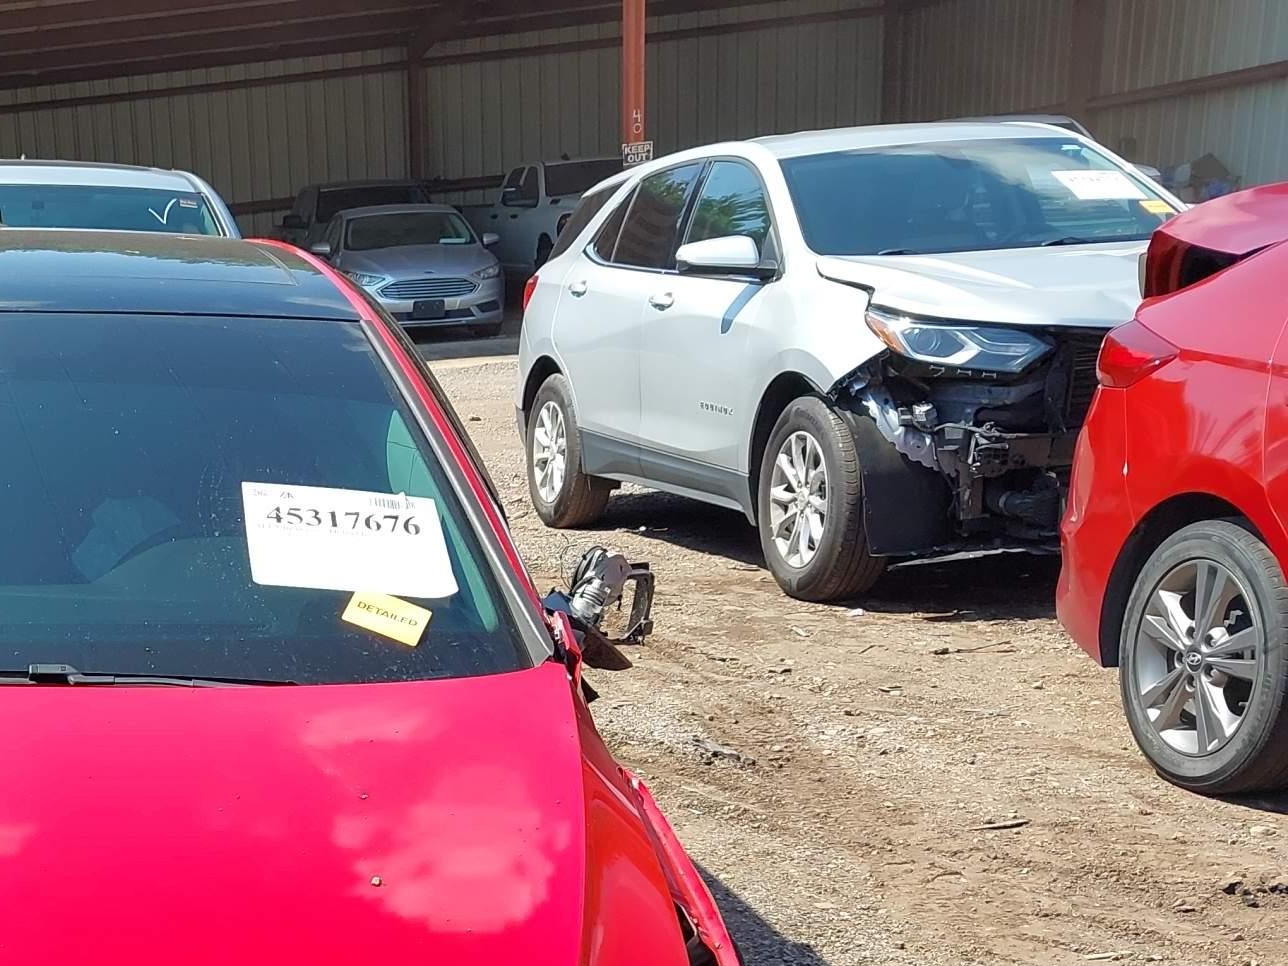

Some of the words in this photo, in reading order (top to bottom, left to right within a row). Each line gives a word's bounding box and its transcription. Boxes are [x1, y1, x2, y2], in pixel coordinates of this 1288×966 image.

[624, 144, 650, 155] KEEP
[627, 152, 649, 163] OUT
[266, 506, 421, 536] 45317676
[357, 601, 418, 626] DETAILED
